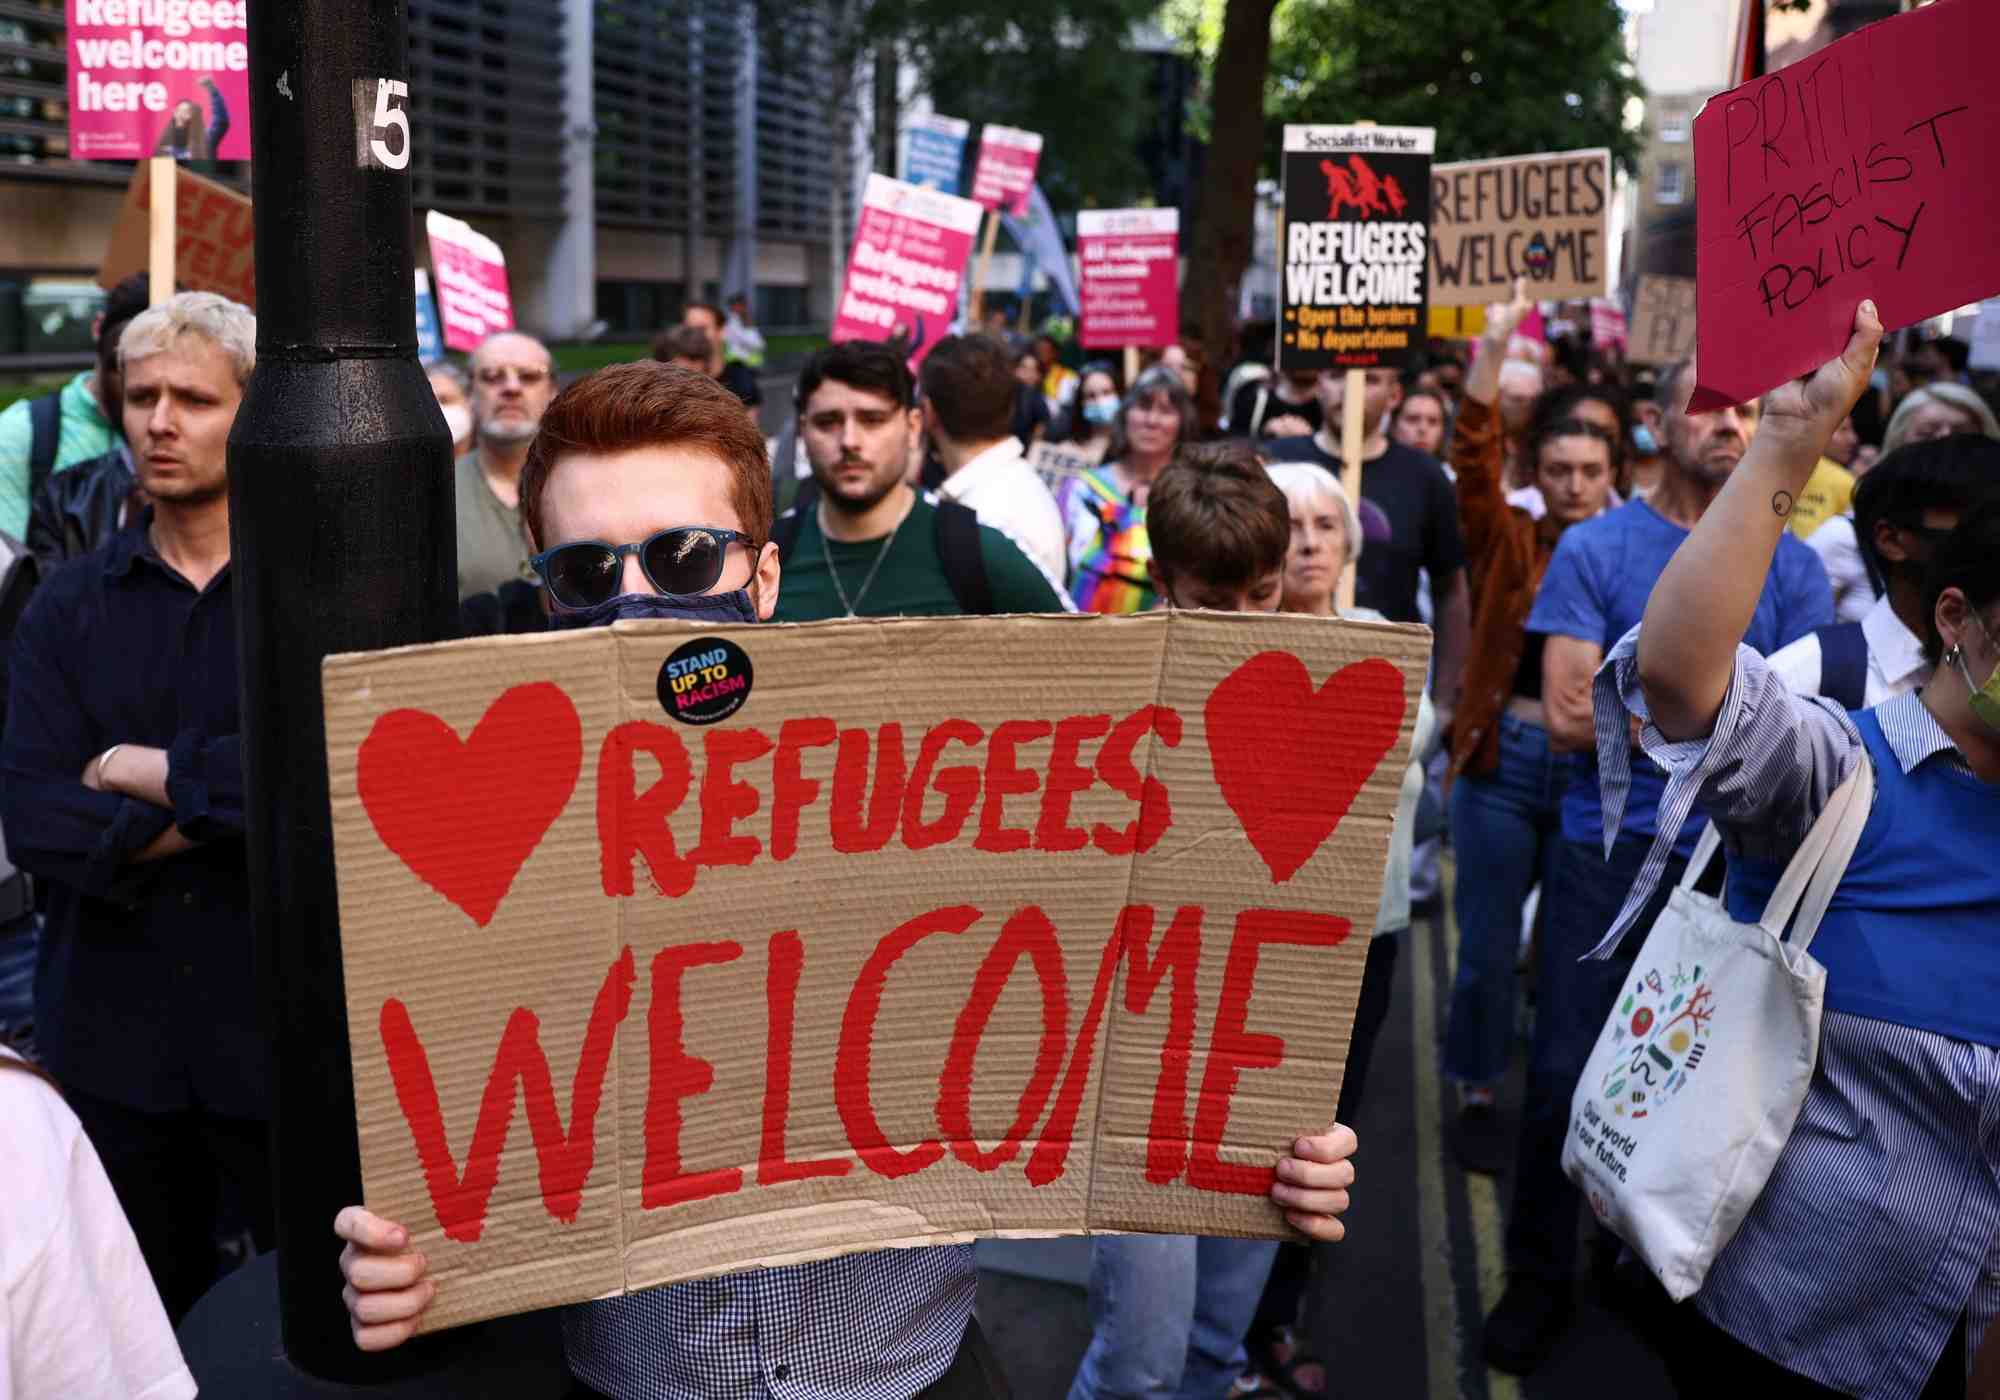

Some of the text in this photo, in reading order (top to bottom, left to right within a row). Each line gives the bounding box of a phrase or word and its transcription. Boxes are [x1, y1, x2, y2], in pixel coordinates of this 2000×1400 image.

[76, 29, 247, 71] welcome
[77, 71, 168, 112] here
[370, 78, 410, 169] 5
[1304, 132, 1369, 148] Socialist
[1431, 159, 1605, 226] REFUGEES
[1736, 105, 1969, 261] FASCIST
[1288, 221, 1427, 265] REFUGEES
[1431, 230, 1599, 287] WELCOME
[1758, 201, 1926, 317] POLICY
[1286, 263, 1423, 306] WELCOME
[666, 647, 728, 680] STAND
[671, 664, 728, 694] UP TO
[675, 674, 745, 711] RACISM
[597, 704, 1182, 898] REFUGEES
[380, 904, 1351, 1243] WELCOME
[1583, 1099, 1638, 1158] Our world
